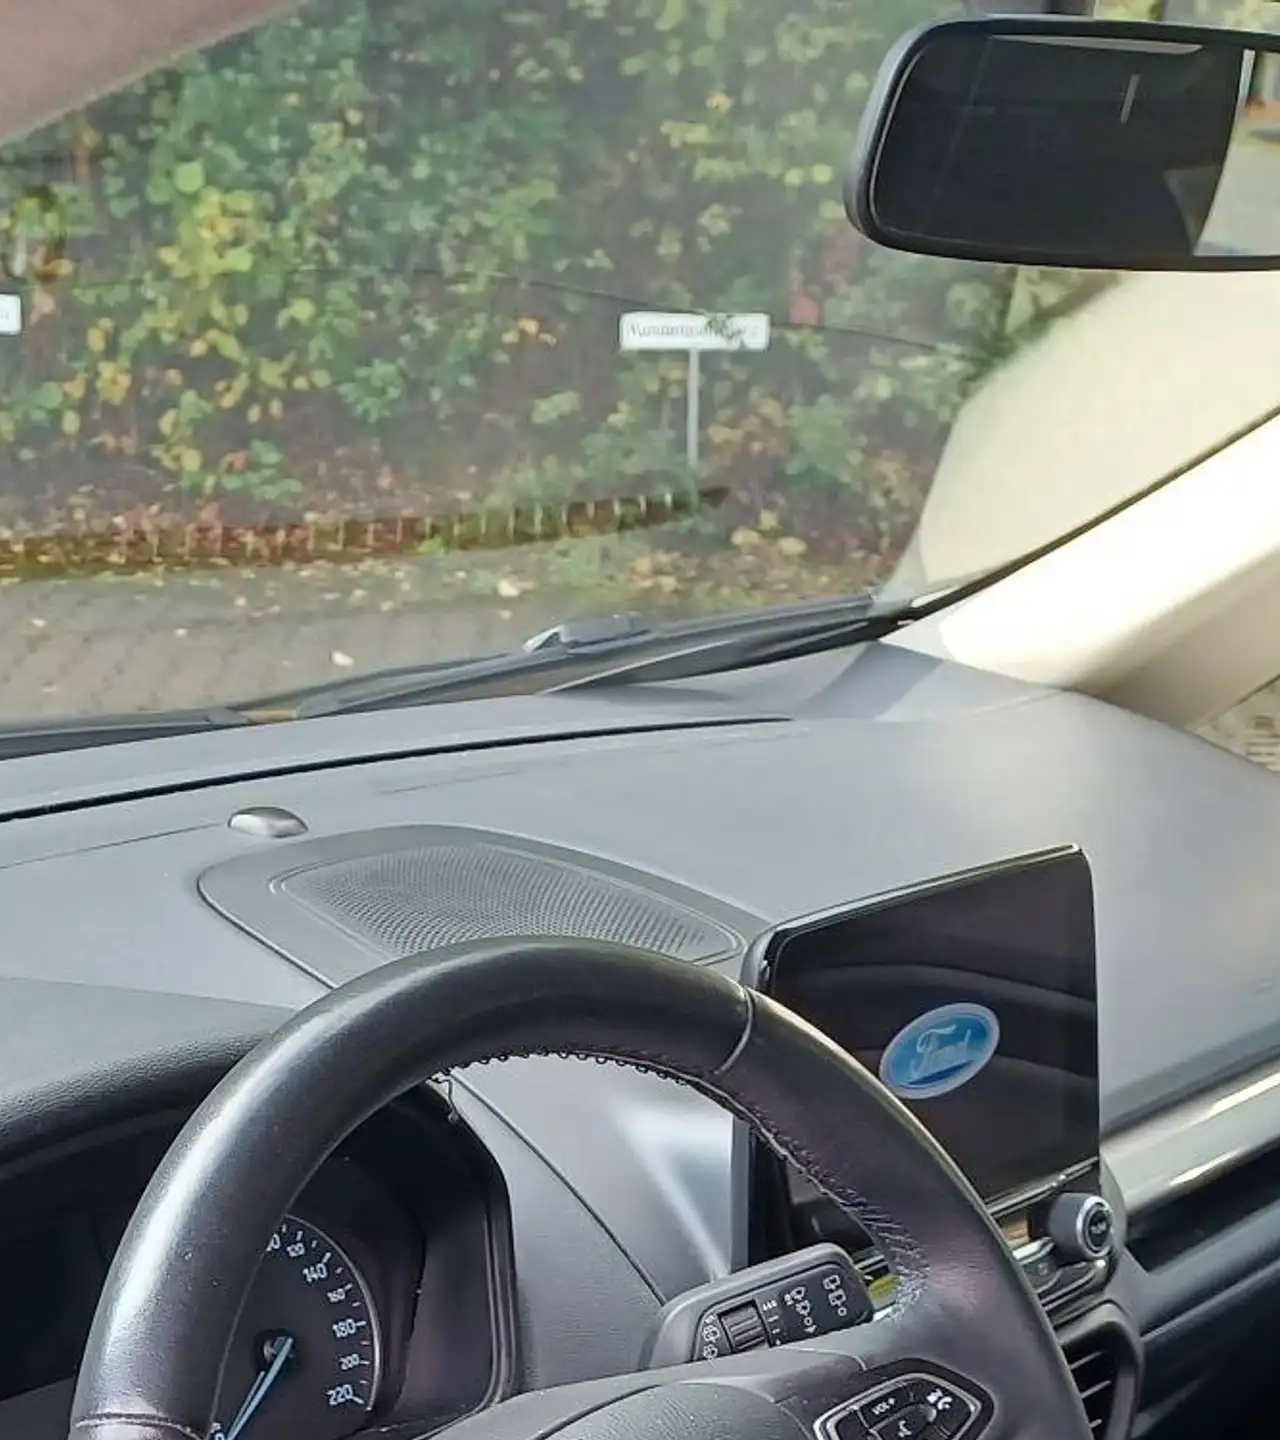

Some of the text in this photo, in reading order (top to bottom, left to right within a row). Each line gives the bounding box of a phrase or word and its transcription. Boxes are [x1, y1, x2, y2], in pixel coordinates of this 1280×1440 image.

[302, 1263, 328, 1282] 140
[332, 1318, 356, 1338] 180
[340, 1353, 360, 1371] 200
[326, 1384, 354, 1406] 220
